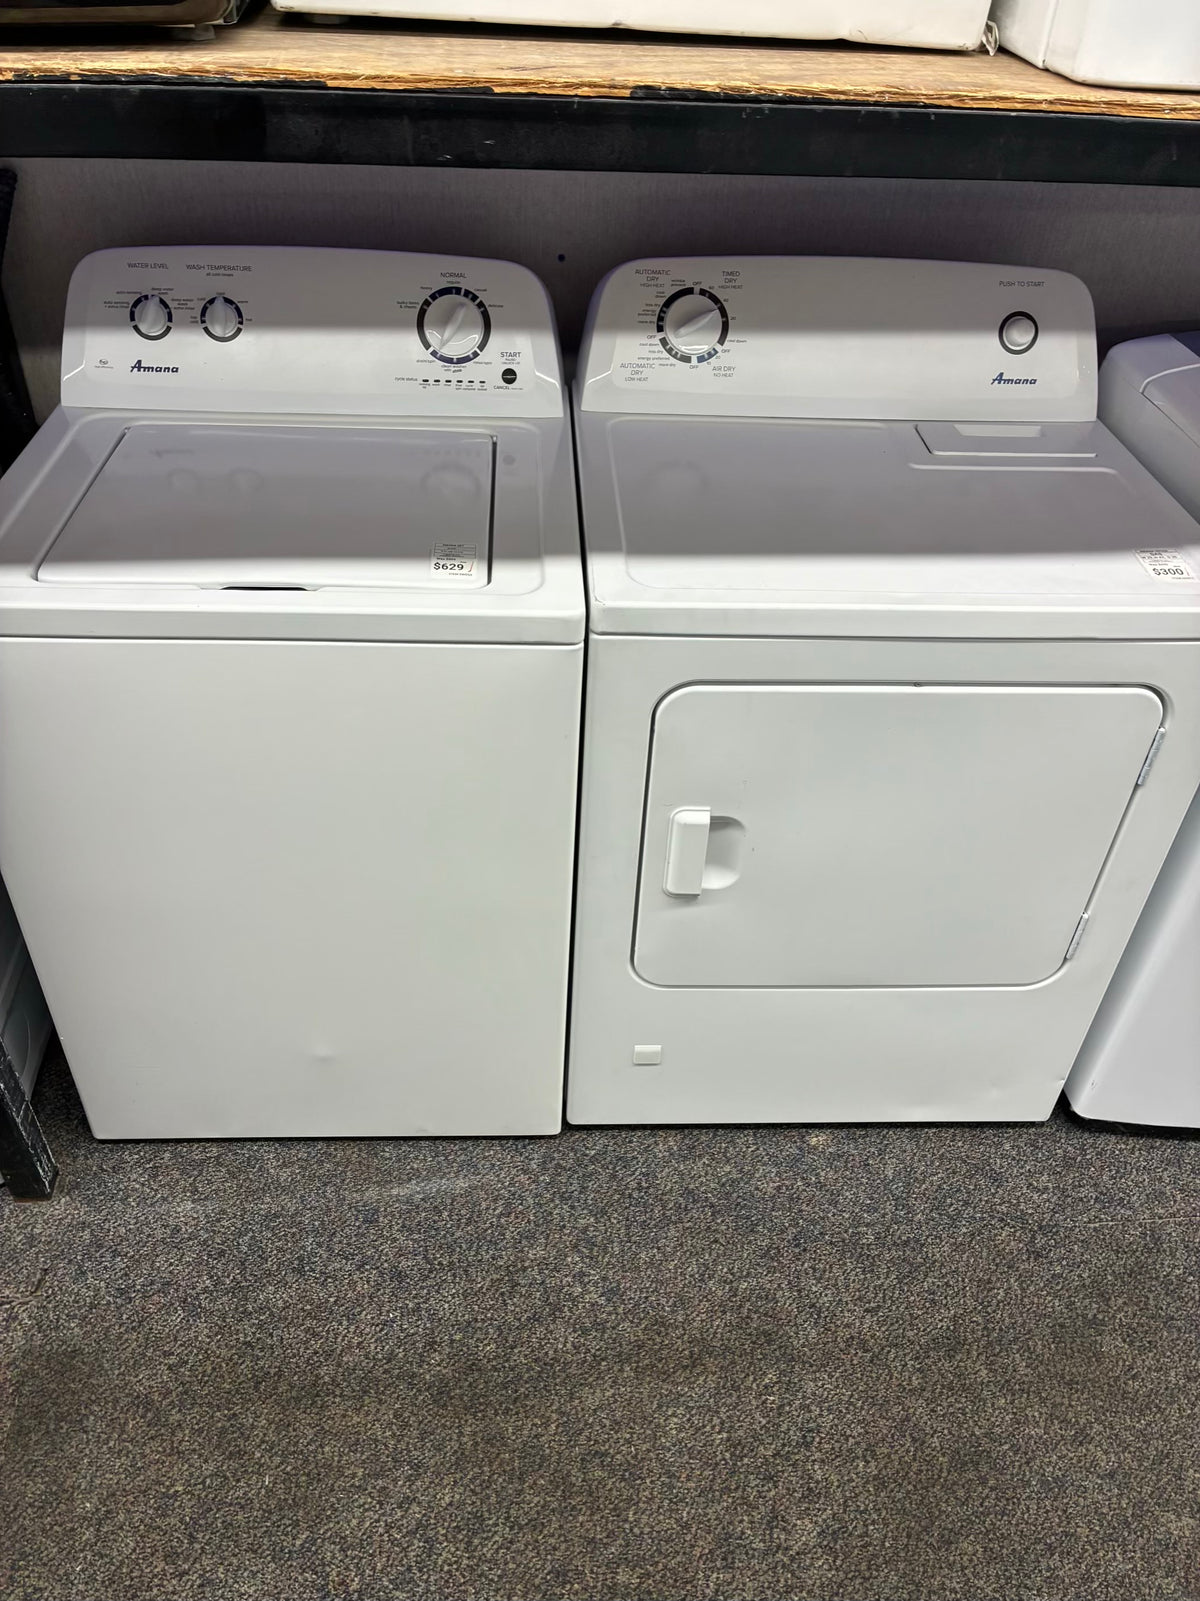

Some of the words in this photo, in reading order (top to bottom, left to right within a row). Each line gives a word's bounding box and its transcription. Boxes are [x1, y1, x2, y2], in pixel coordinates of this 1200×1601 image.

[130, 360, 179, 373] Amana
[991, 372, 1037, 384] Amana
[434, 562, 464, 570] $629
[1153, 568, 1184, 576] $300
